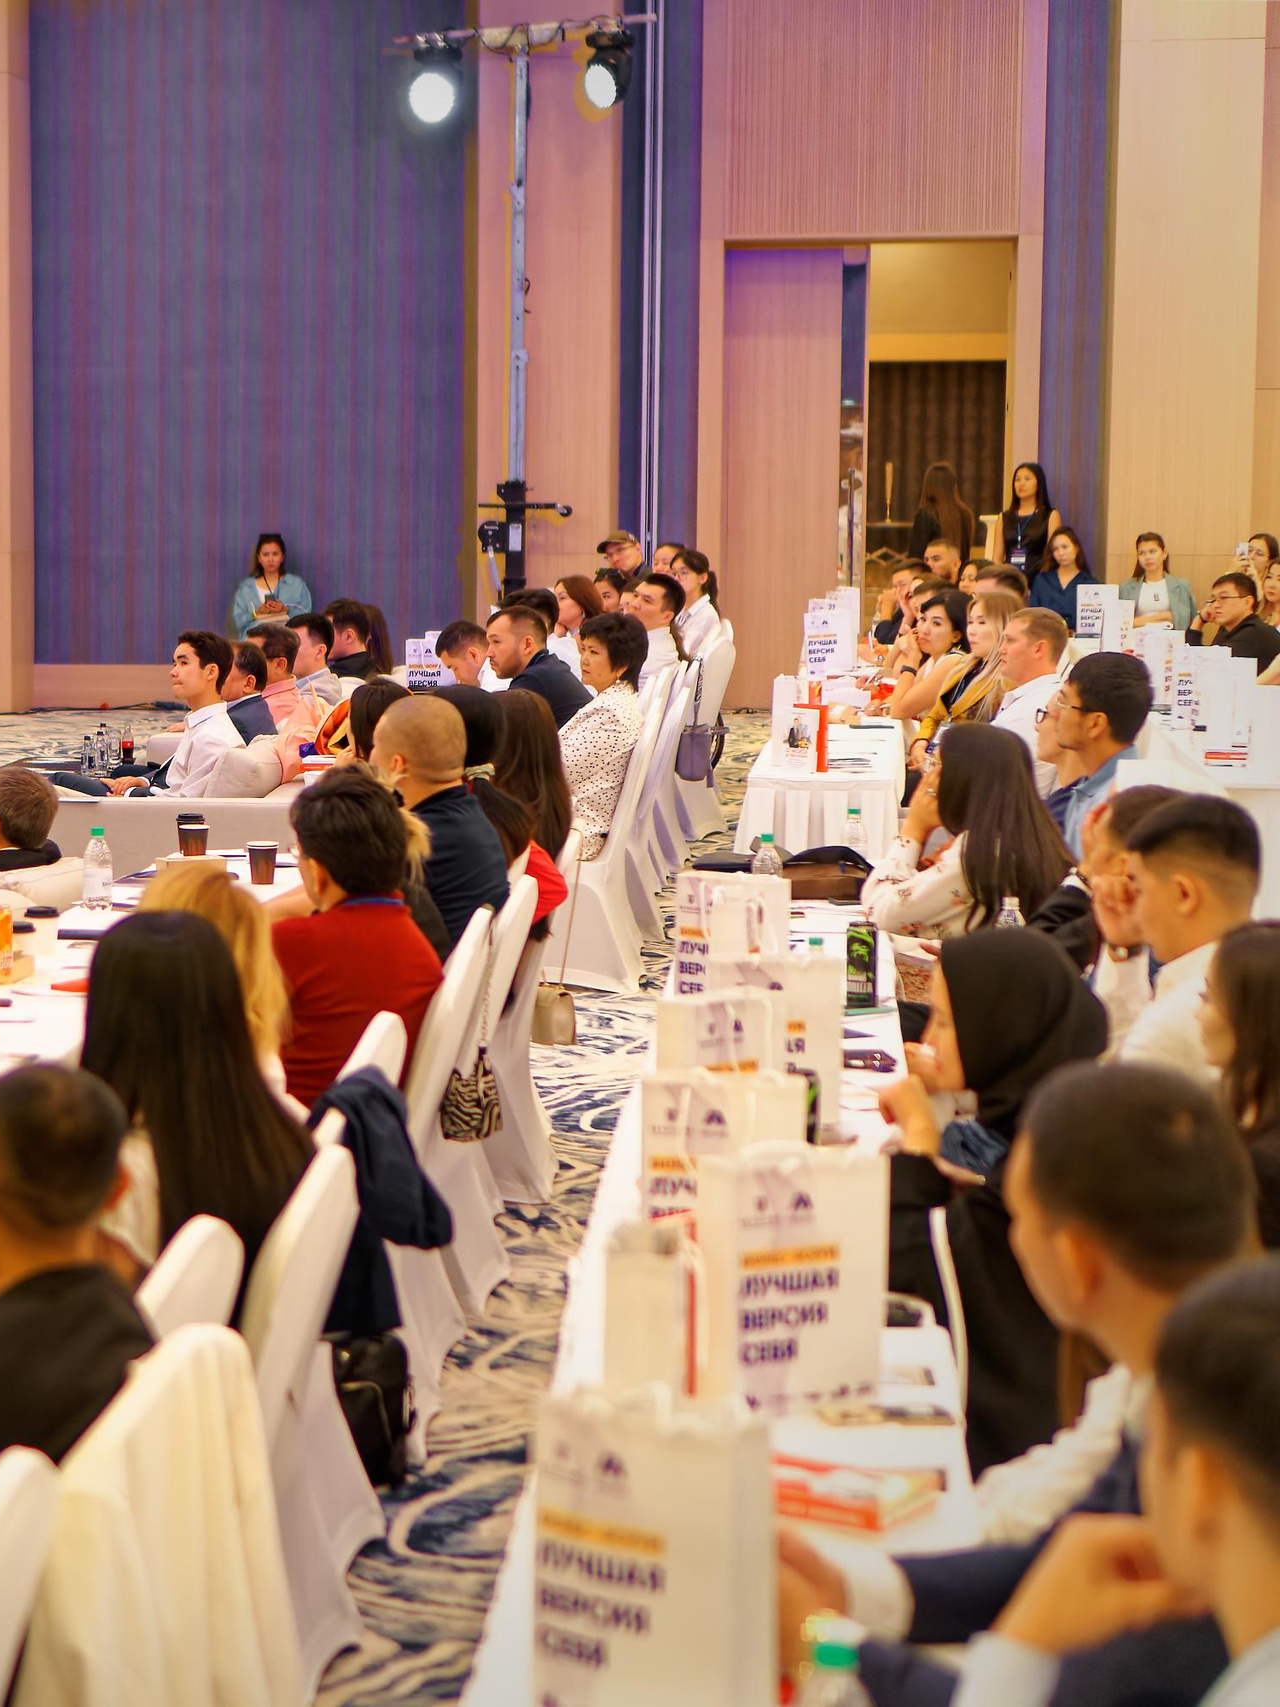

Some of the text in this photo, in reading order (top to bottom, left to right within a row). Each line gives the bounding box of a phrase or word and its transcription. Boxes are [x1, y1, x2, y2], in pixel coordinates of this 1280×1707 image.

[808, 639, 838, 647] ЛУЧШАЯ
[808, 647, 835, 655] ВЕРСИЯ
[679, 940, 709, 955] ЛУЧ
[679, 961, 706, 975] ВЕР
[679, 981, 704, 994] СЕ
[649, 1177, 697, 1196] ЛУЧ
[740, 1268, 839, 1297] ЛУЧШАЯ
[740, 1302, 828, 1331] ВЕРСИЯ
